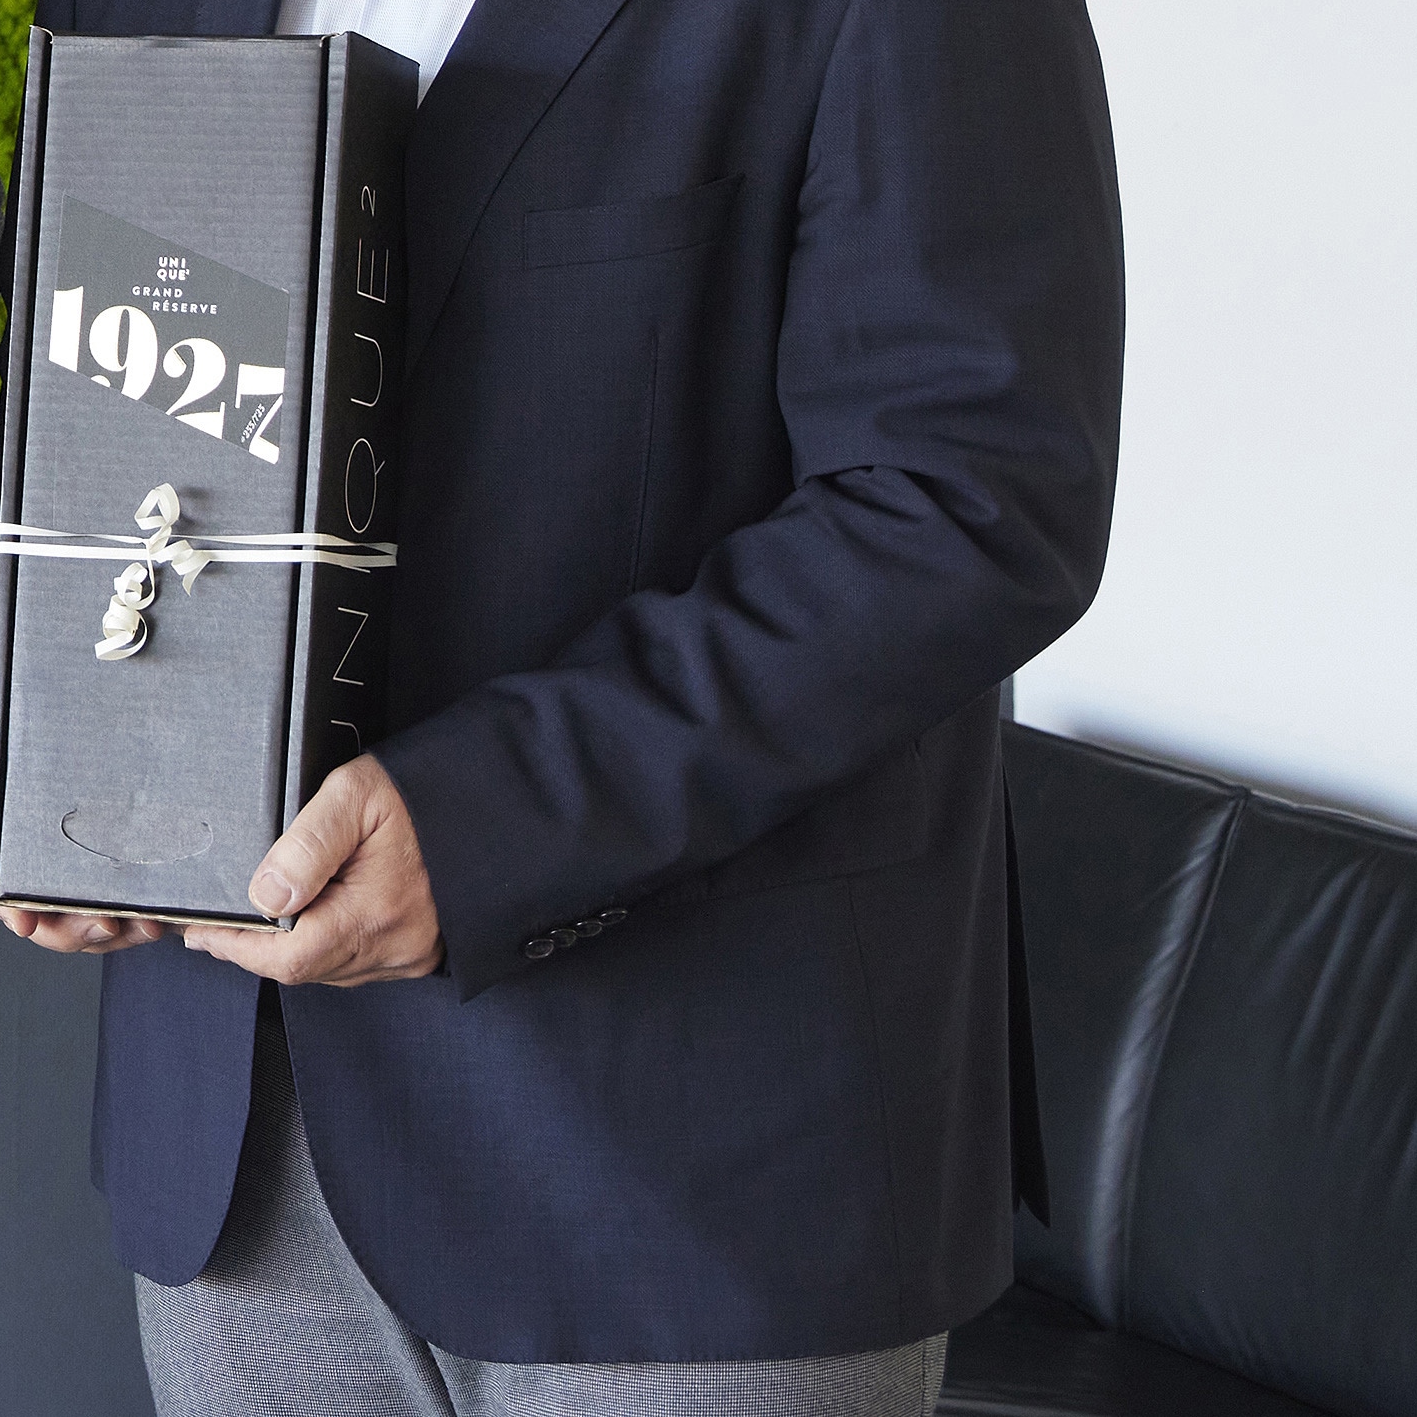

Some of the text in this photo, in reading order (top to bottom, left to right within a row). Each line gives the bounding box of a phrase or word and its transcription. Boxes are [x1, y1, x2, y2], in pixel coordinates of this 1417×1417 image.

[158, 256, 186, 269] UNI
[131, 285, 183, 298] GRAND
[152, 299, 218, 315] RÉSERVE
[48, 285, 286, 464] 1927
